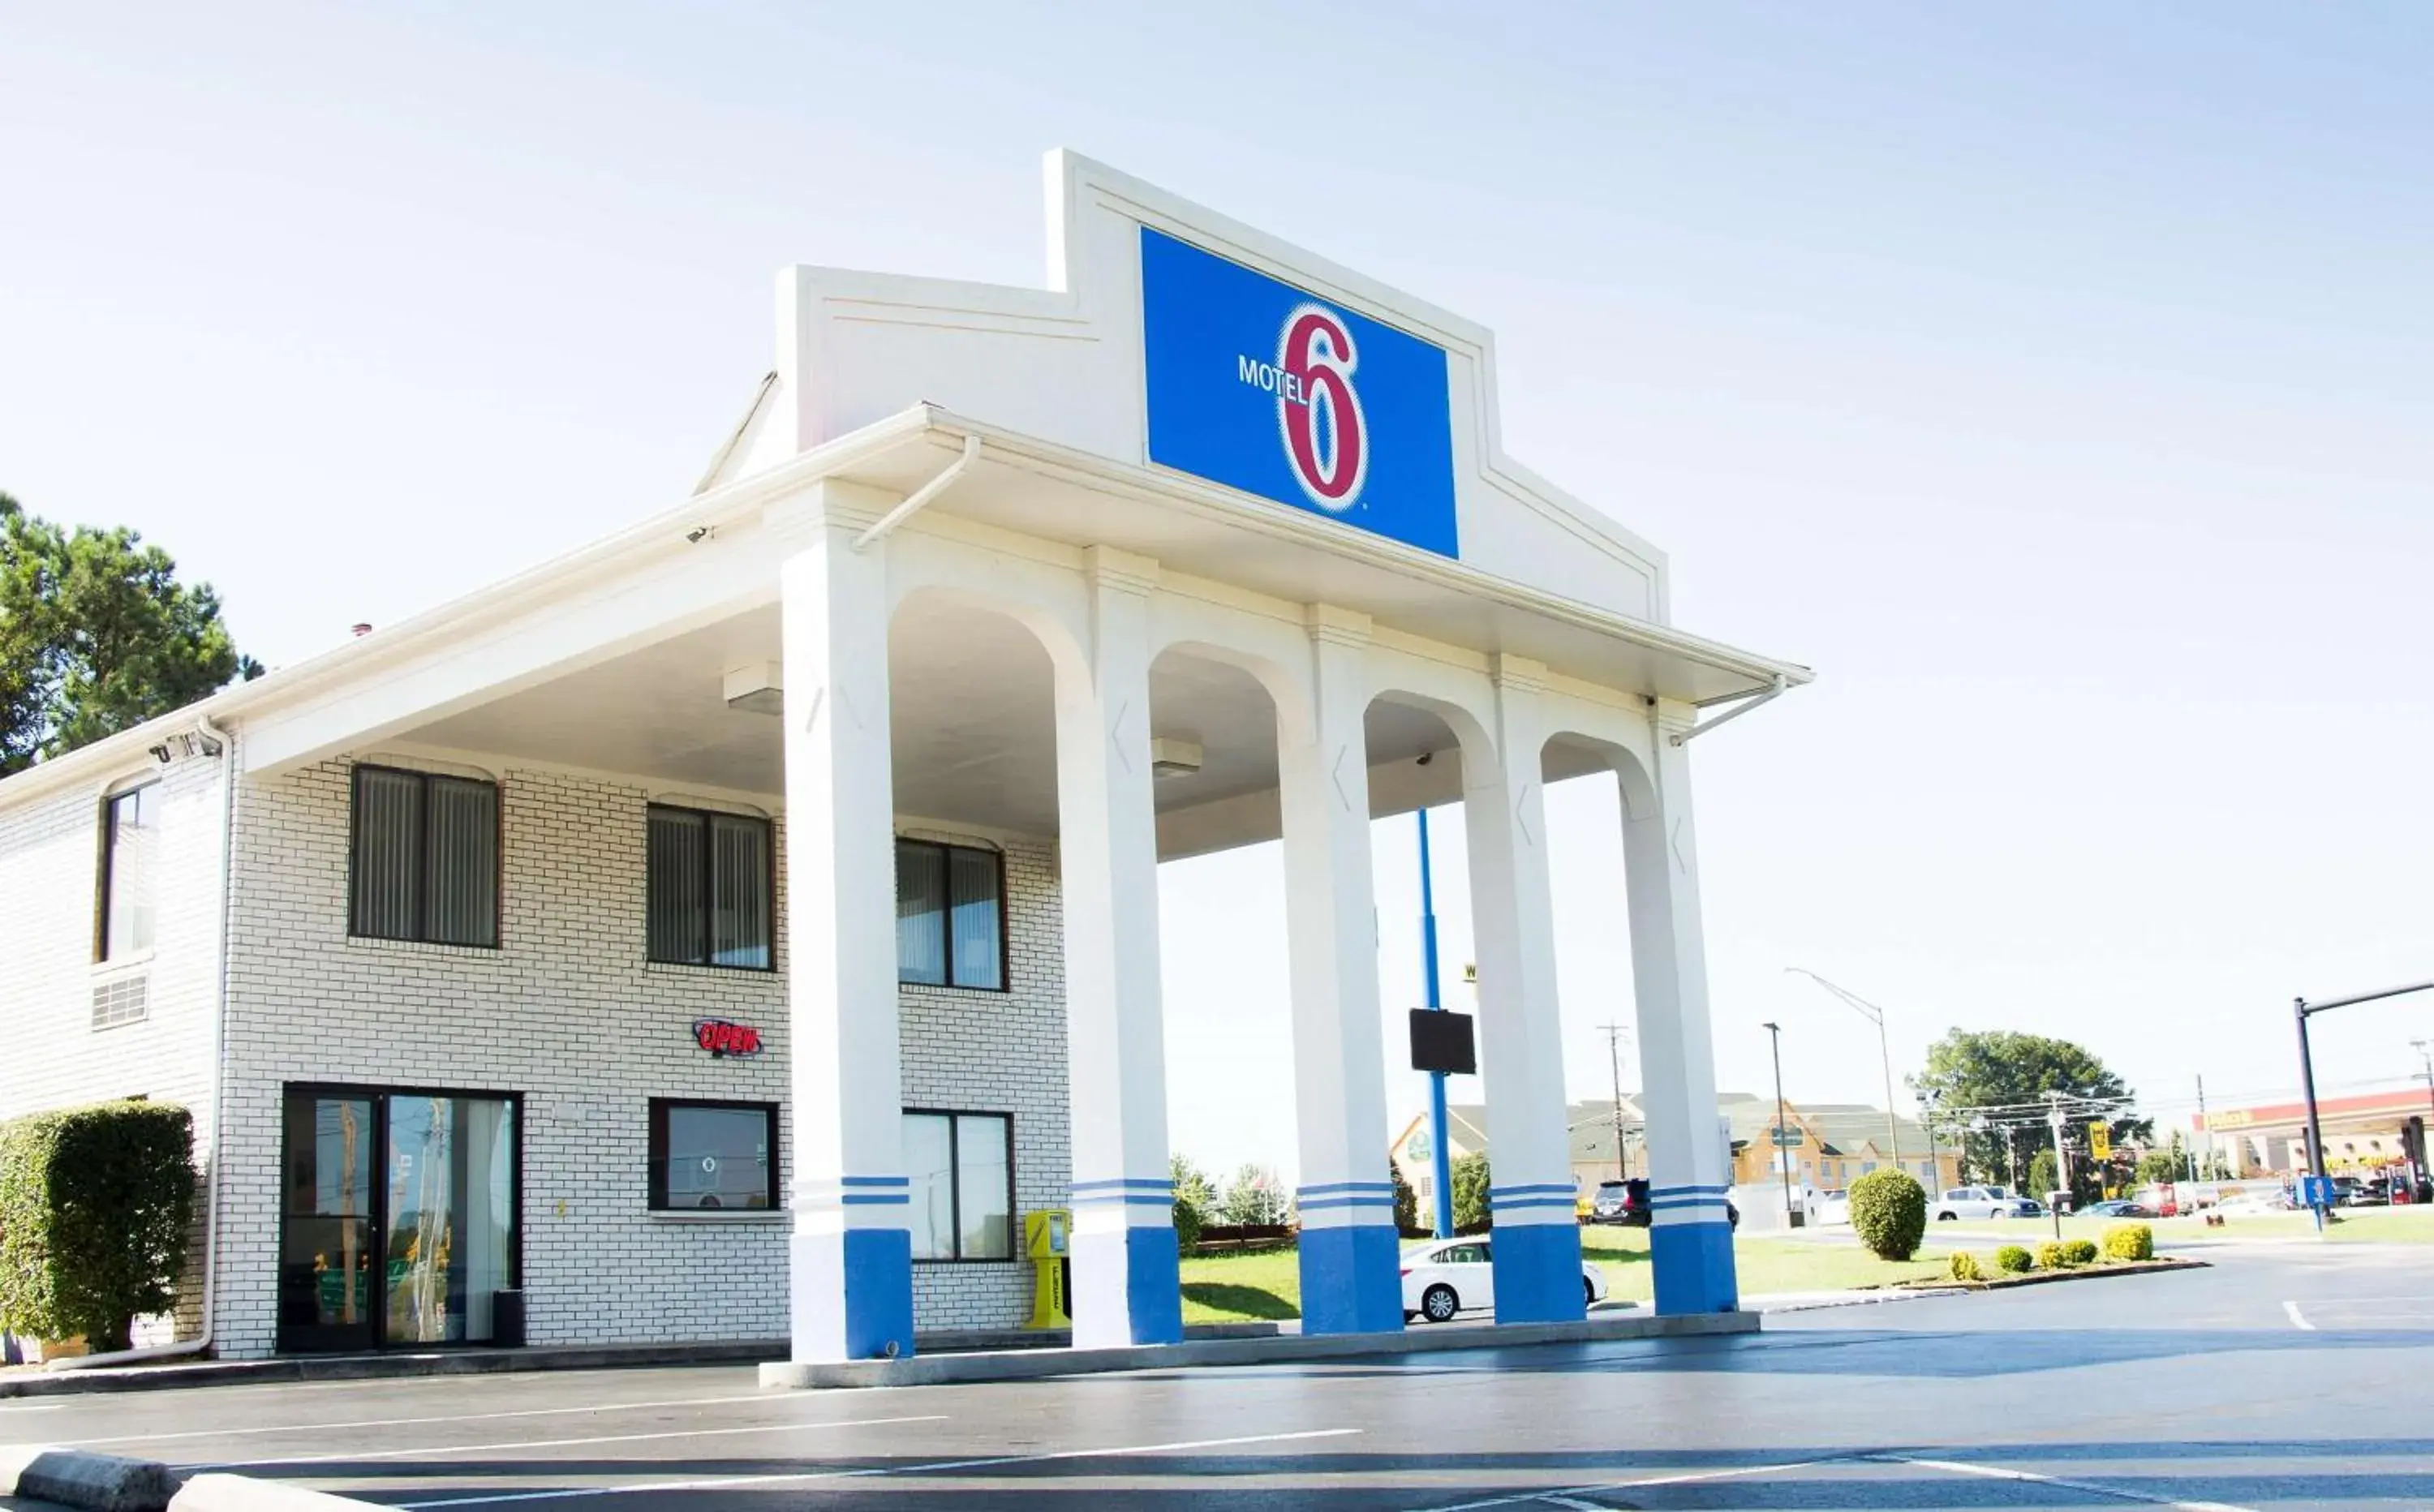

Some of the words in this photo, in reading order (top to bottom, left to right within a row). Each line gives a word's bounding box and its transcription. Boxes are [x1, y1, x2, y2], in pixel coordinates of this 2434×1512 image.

[1238, 354, 1309, 406] MOTEL
[1279, 305, 1366, 507] 6
[700, 1022, 758, 1052] OPEN
